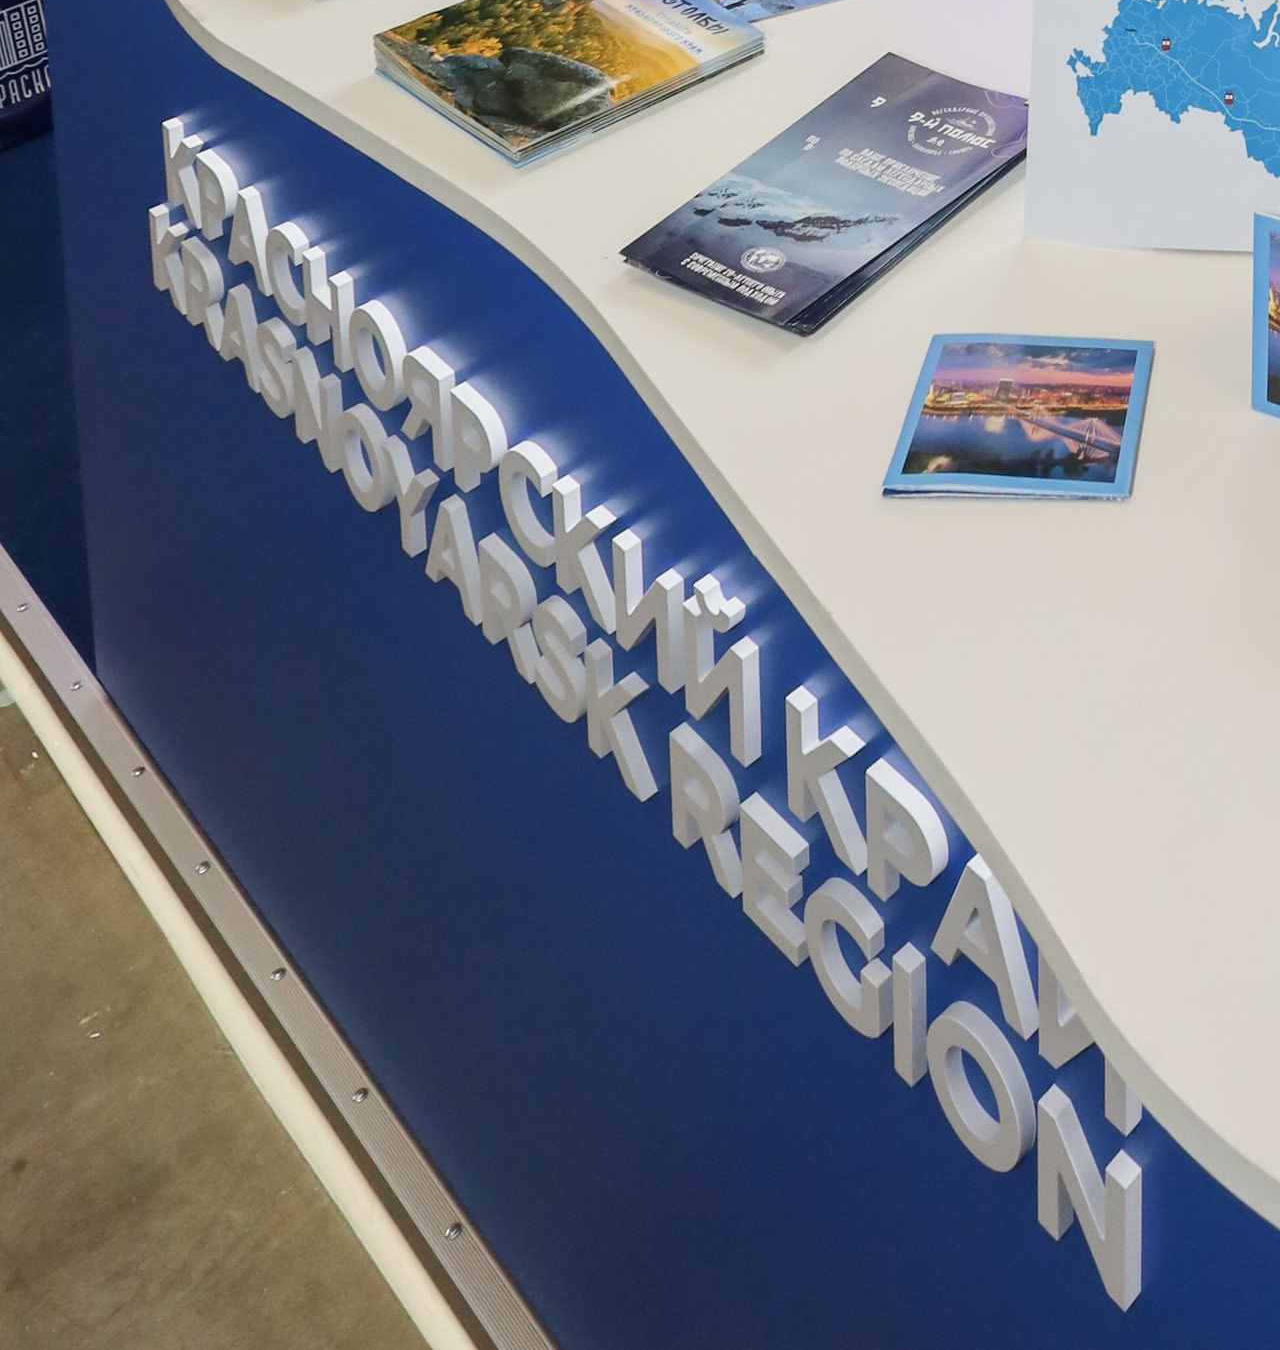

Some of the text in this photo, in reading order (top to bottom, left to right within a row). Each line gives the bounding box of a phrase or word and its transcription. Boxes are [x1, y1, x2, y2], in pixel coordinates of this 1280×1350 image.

[161, 116, 763, 768] КРАСНОЯРСКИЙ
[937, 123, 997, 149] ПОЛЮС
[149, 202, 1142, 1313] KRASNOYARSK REGION
